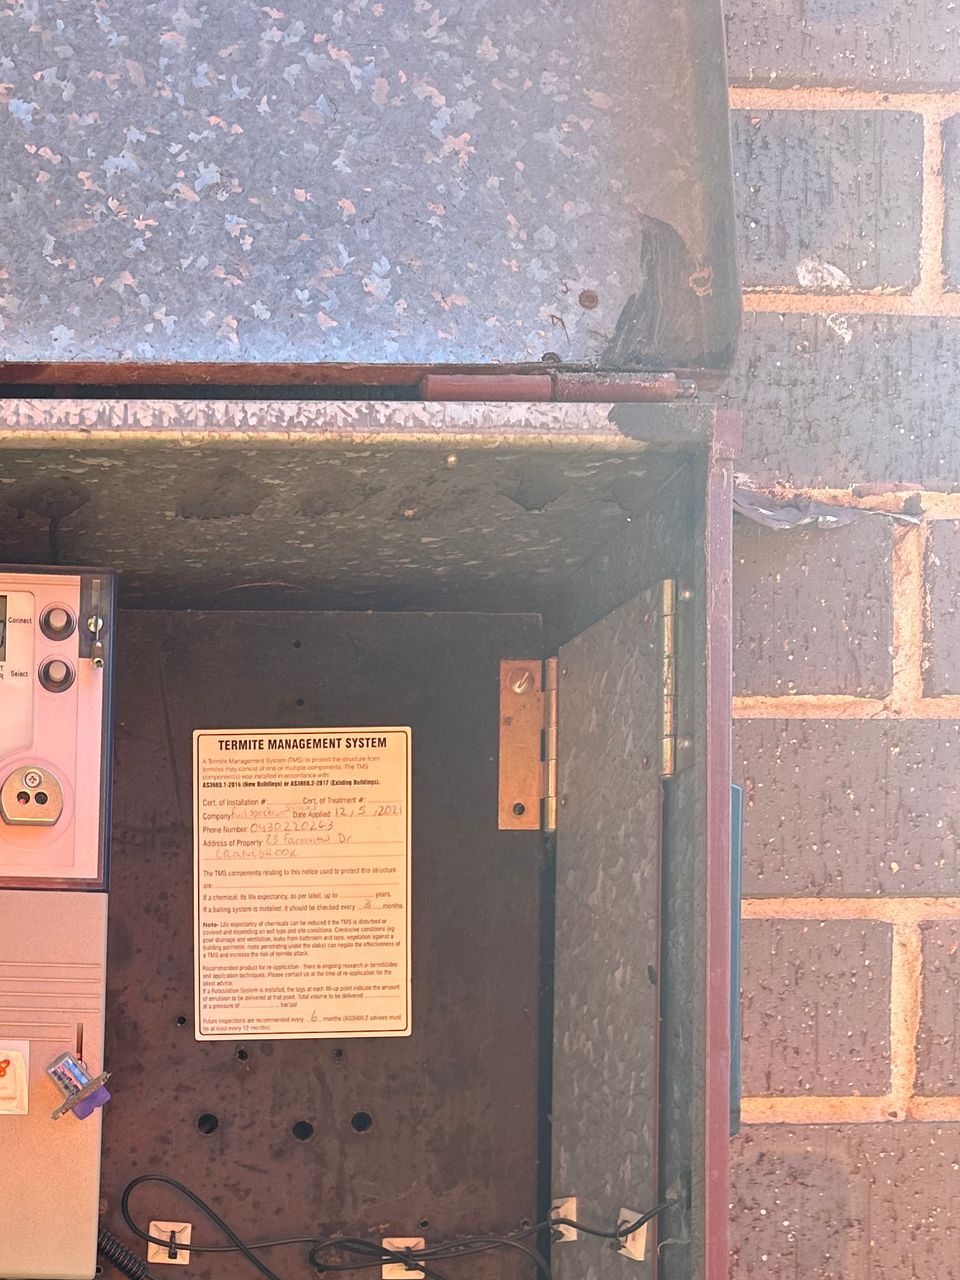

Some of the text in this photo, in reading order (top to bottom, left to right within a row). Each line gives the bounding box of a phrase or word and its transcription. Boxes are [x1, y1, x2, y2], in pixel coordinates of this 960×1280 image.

[218, 737, 387, 751] TERMITE MANAGEMENT SYSTEM
